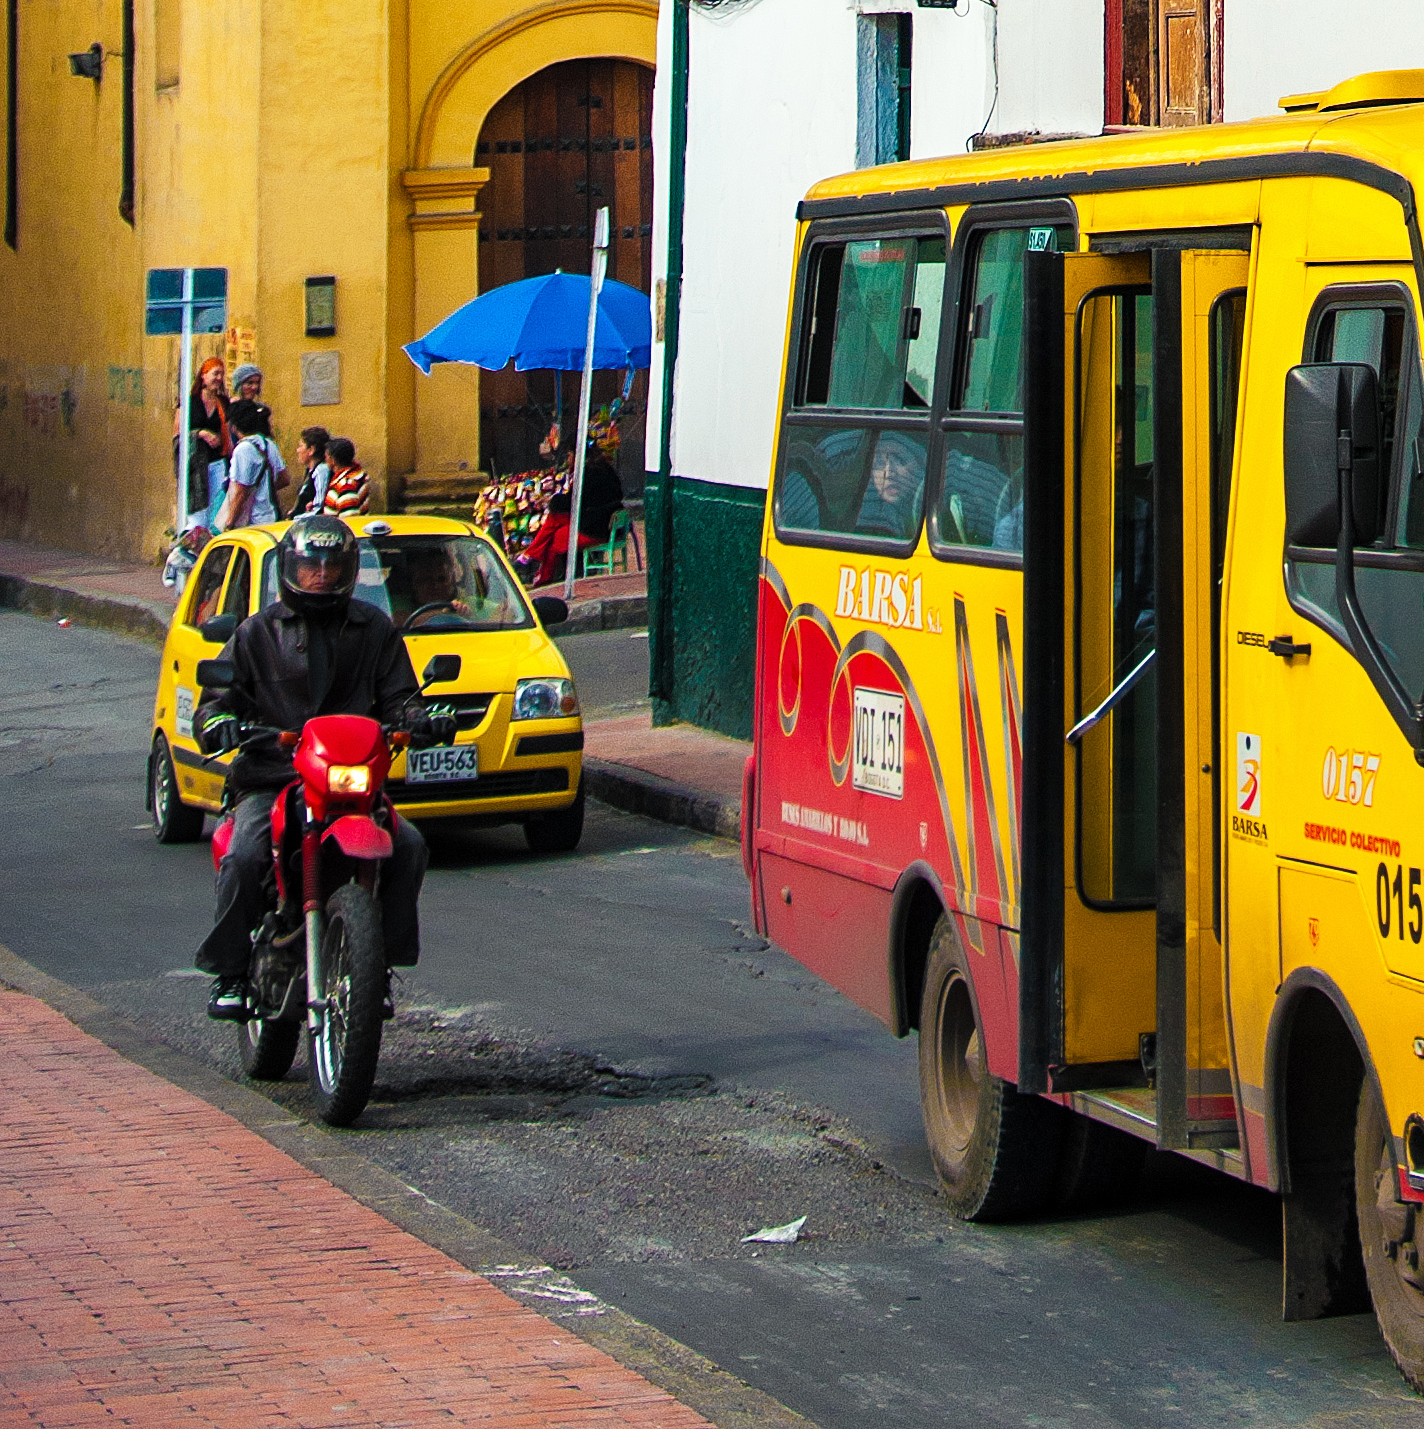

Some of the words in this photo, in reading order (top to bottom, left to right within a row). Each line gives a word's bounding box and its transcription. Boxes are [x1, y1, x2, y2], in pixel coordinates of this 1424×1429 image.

[835, 565, 924, 631] BARSA
[1236, 630, 1269, 649] DIESEL
[1322, 746, 1382, 809] 0157
[1232, 815, 1268, 840] BARSA
[1304, 822, 1347, 846] SERVICIO
[1350, 830, 1401, 858] COLECTIVO
